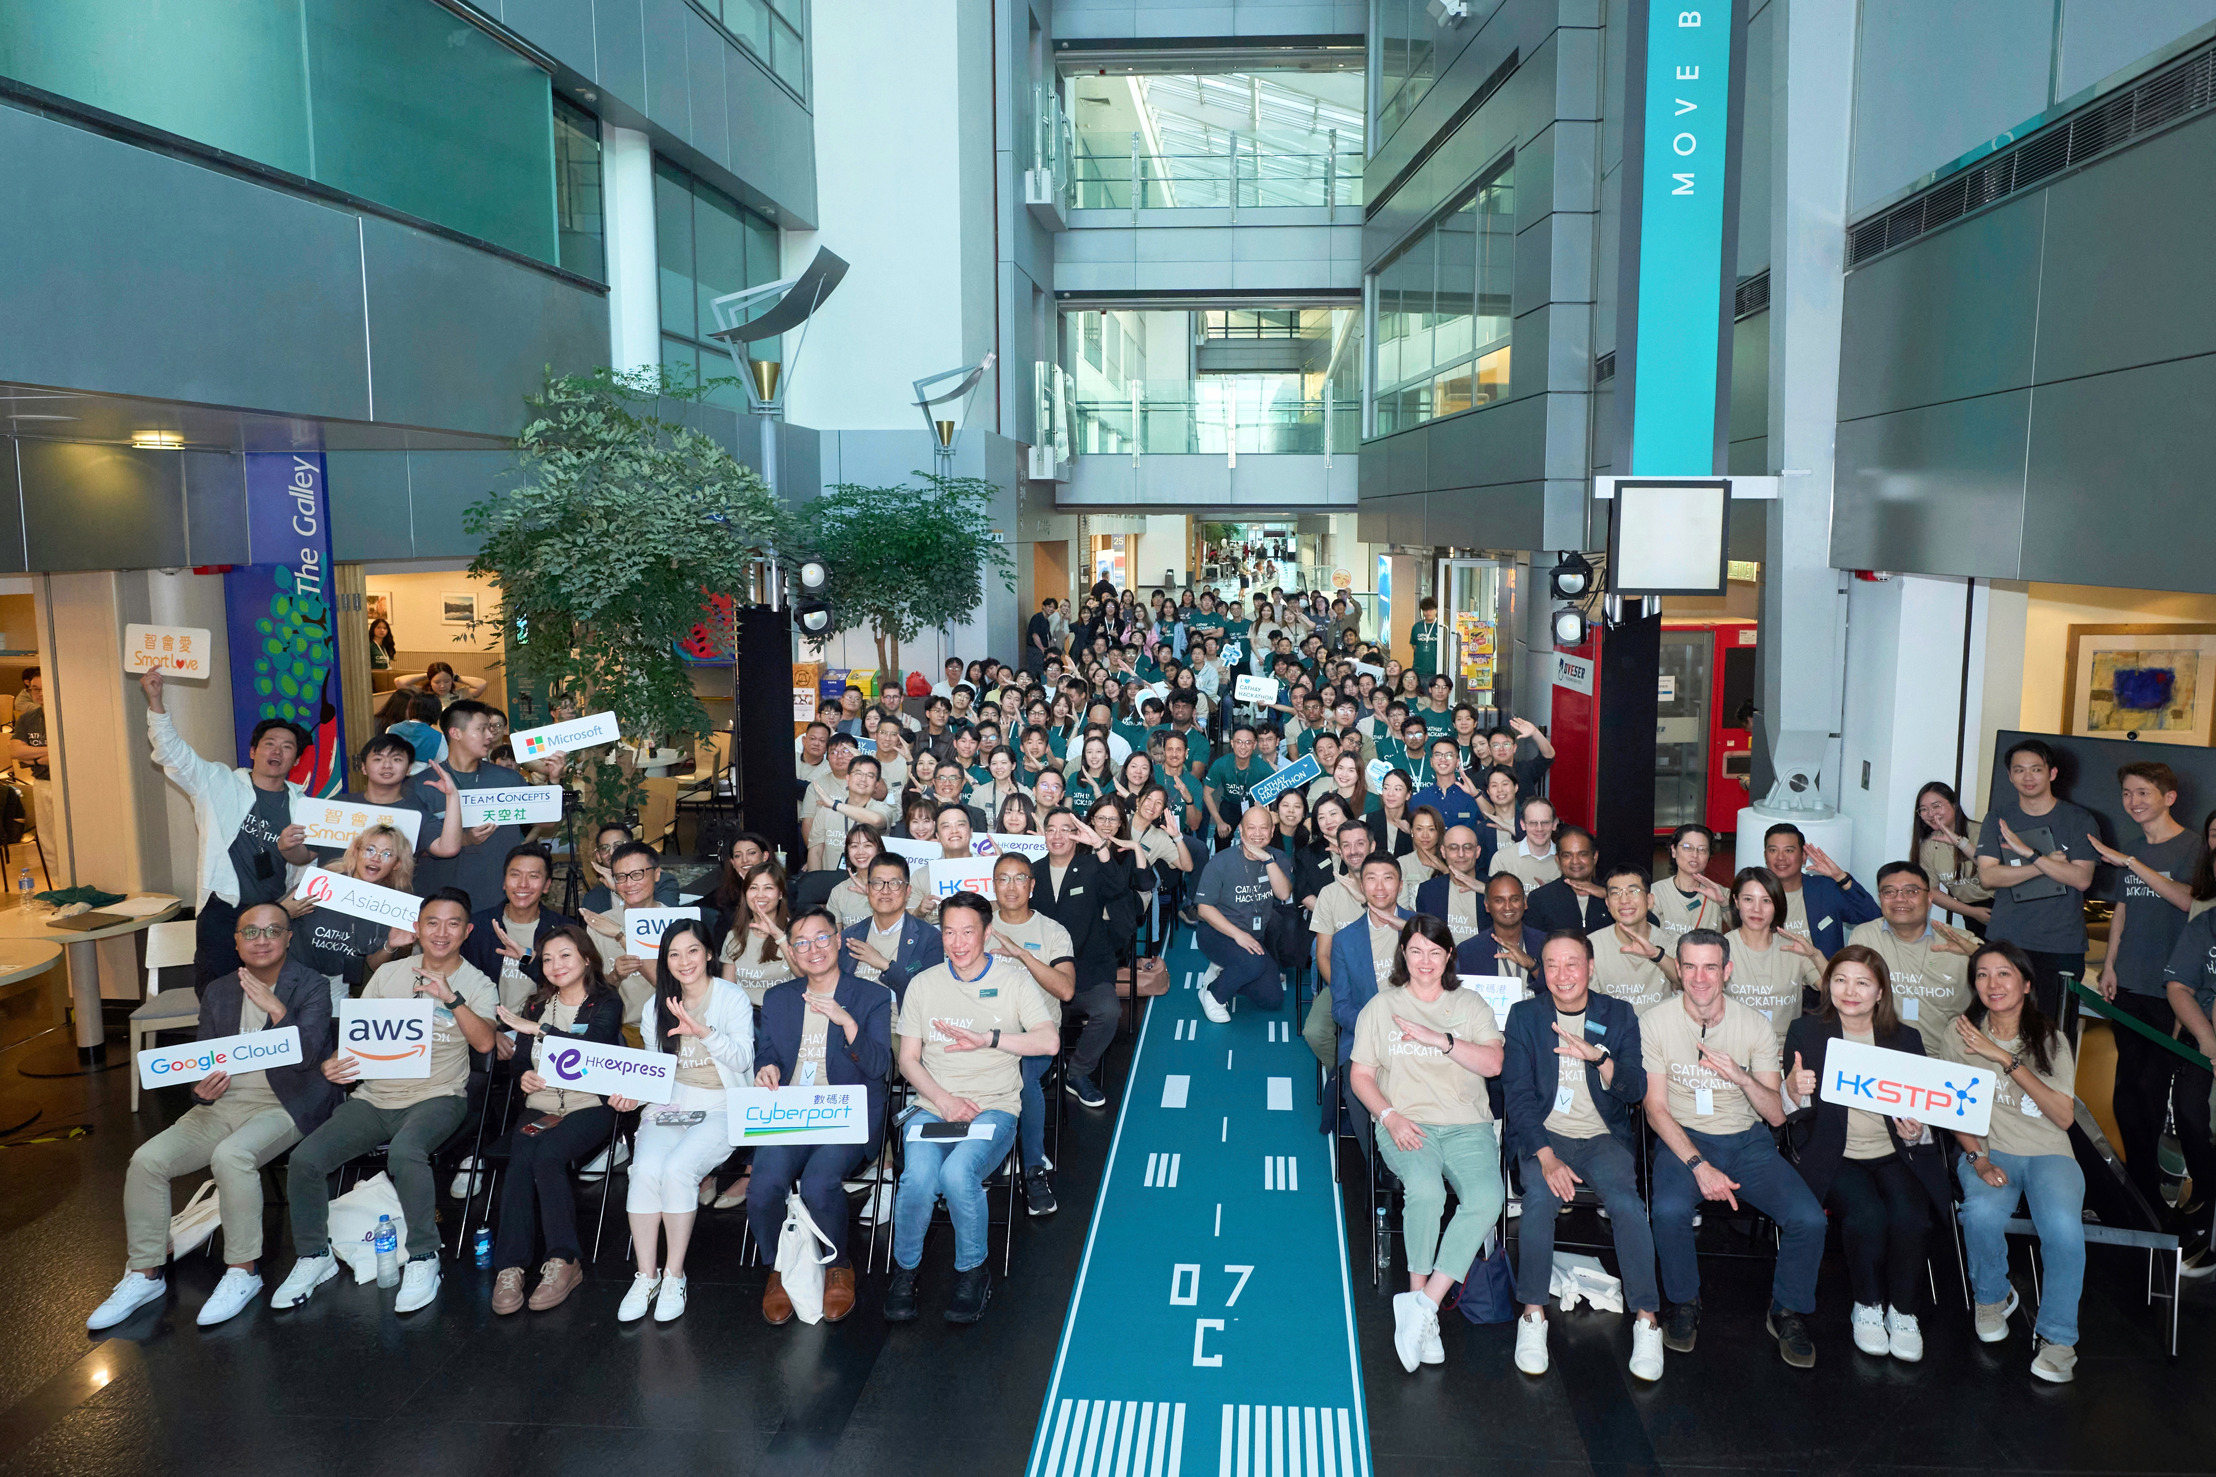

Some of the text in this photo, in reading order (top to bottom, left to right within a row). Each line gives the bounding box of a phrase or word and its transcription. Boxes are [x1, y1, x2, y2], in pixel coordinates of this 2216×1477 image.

[1671, 65, 1699, 195] MOVE
[288, 455, 321, 595] The Galley
[1113, 537, 1124, 545] 25
[144, 633, 192, 654] 智會愛
[1238, 692, 1274, 701] HACKATHON
[548, 725, 603, 747] Microsoft
[1257, 775, 1286, 796] CATHAY
[1260, 770, 1307, 802] HACKATHON
[483, 808, 527, 823] 天空社
[306, 824, 357, 842] Smart
[938, 877, 993, 895] HKST
[340, 889, 418, 923] Asiabots
[1447, 914, 1469, 924] THAY
[1785, 919, 1804, 930] HAY
[736, 967, 765, 979] ATHAY
[1889, 972, 1924, 984] ATHAY
[1606, 983, 1645, 994] CATHAY
[1730, 983, 1773, 995] CATHAY
[1890, 984, 1955, 998] ACKATHON
[348, 1018, 424, 1041] aws
[929, 1017, 974, 1029] CTHAY
[150, 1038, 290, 1075] Google Cloud
[1388, 1043, 1444, 1057] HACKATH
[1672, 1075, 1735, 1090] HACKATH
[1836, 1070, 1953, 1112] HKSTP
[813, 1093, 850, 1106] 數碼港
[746, 1101, 853, 1129] Cyberport
[1192, 1318, 1225, 1367] C
